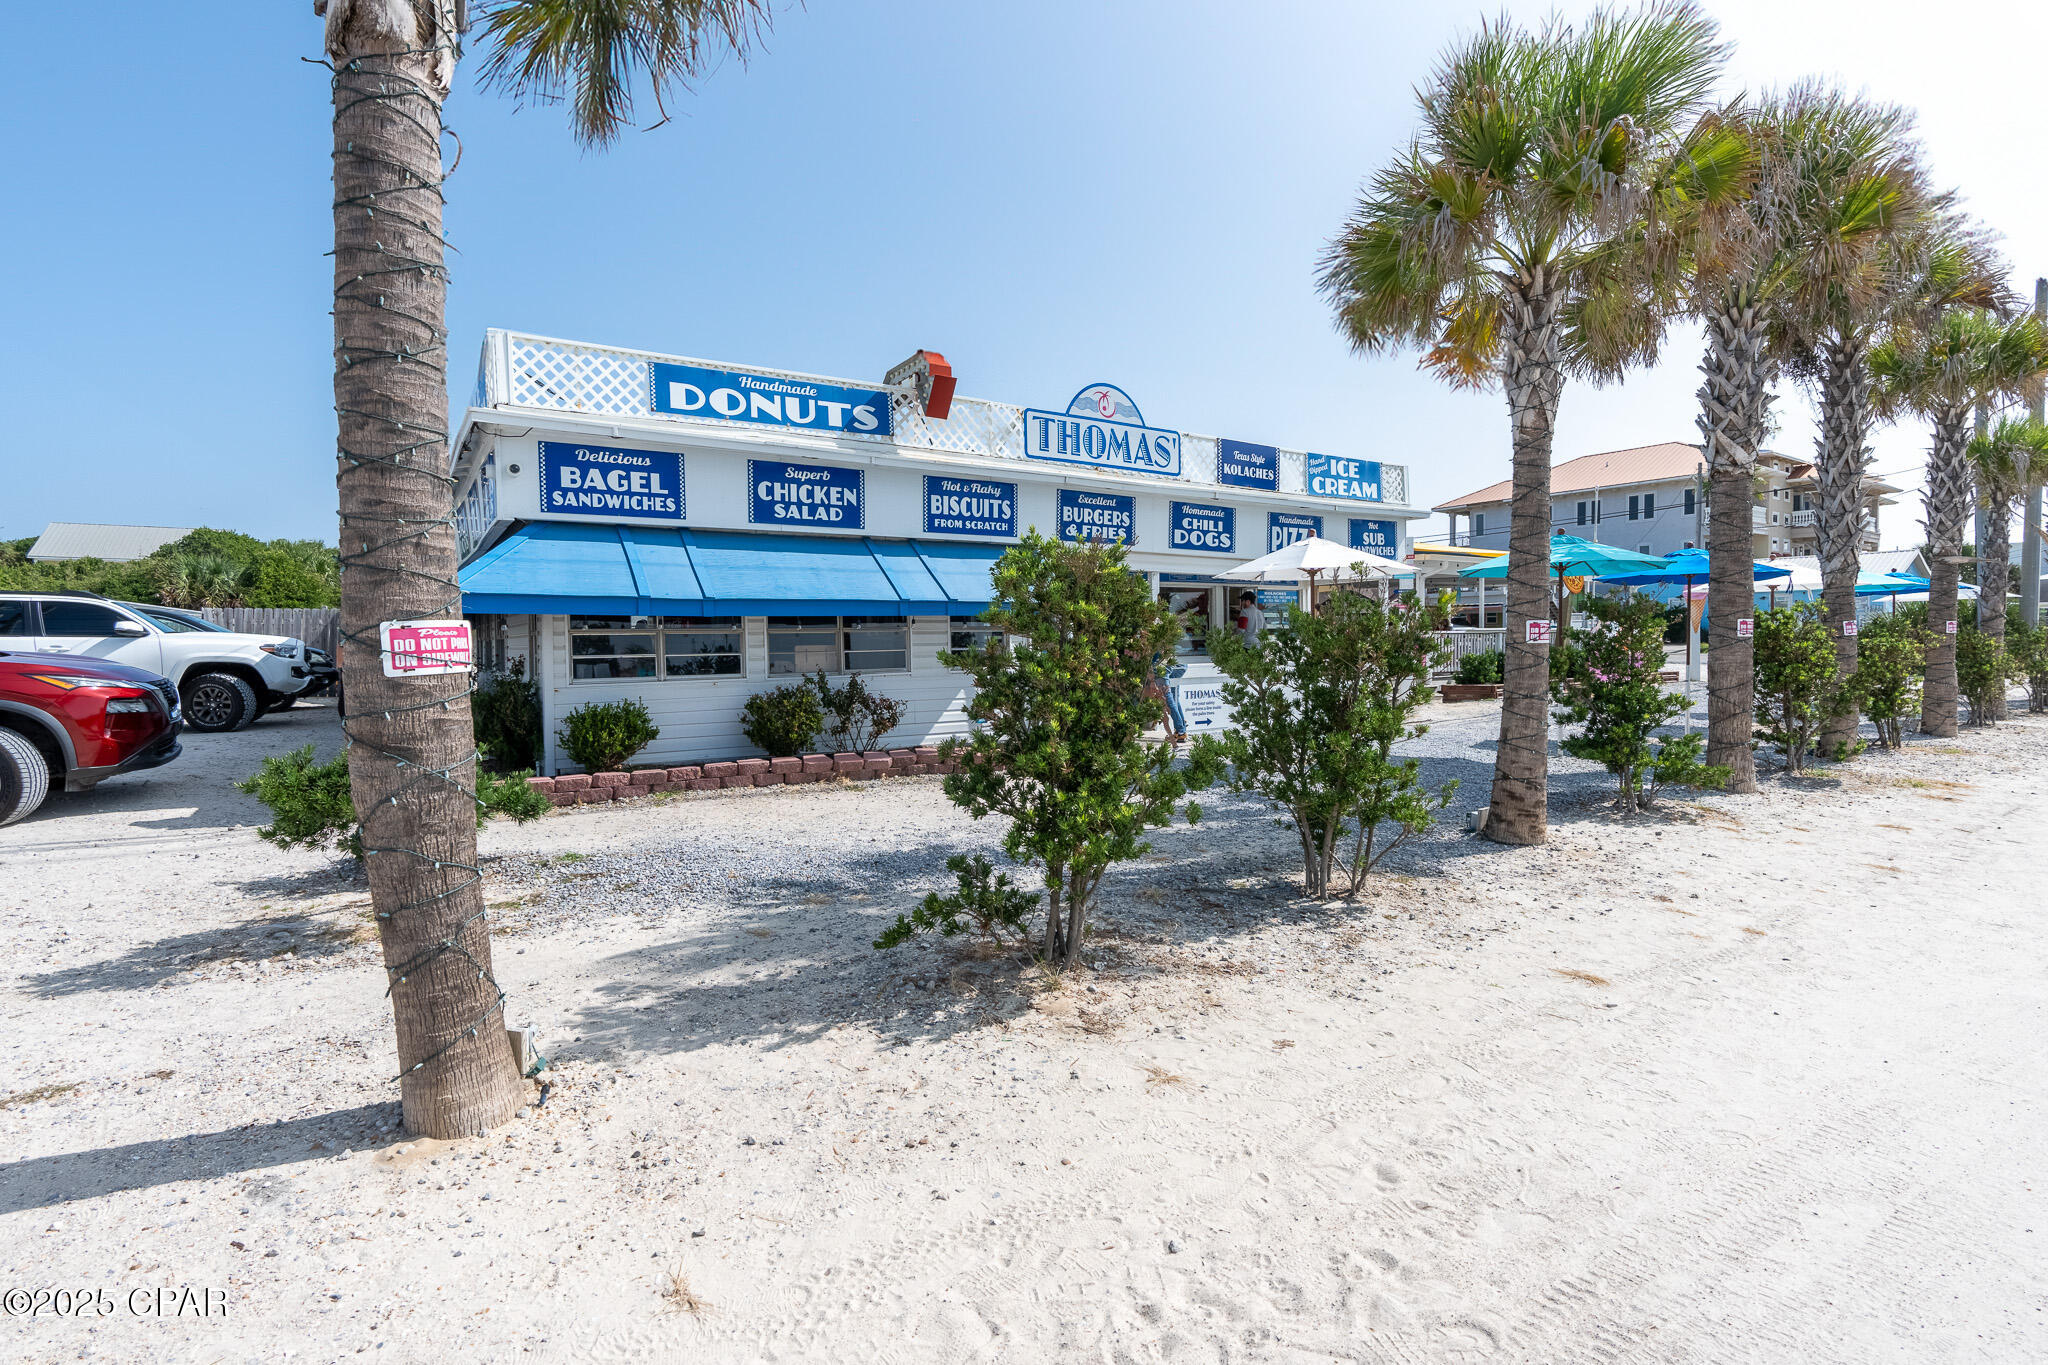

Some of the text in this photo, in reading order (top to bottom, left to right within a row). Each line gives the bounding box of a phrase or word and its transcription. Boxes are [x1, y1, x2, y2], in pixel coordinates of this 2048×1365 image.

[739, 376, 818, 397] Handmade
[669, 381, 879, 431] DONUTS
[1032, 416, 1176, 468] THOMAS'
[575, 449, 652, 466] Delicious
[1233, 451, 1266, 465] Texas Style
[1309, 455, 1326, 467] Hand
[785, 467, 831, 482] Superb
[1223, 463, 1275, 481] KOLACHES
[1309, 463, 1328, 475] Dipped
[1330, 459, 1360, 478] ICE
[560, 466, 669, 494] BAGEL
[1312, 476, 1378, 499] CREAM
[758, 481, 857, 507] CHICKEN
[941, 481, 961, 492] Hot
[970, 483, 1001, 497] Flaky
[552, 491, 676, 512] SANDWICHES
[930, 494, 1011, 519] BISCUITS
[1078, 494, 1117, 507] Excellent
[774, 504, 843, 521] SALAD
[1063, 506, 1130, 527] BURGERS
[1182, 505, 1225, 517] Homemade
[934, 519, 1008, 531] FROM SCRATCH
[1182, 517, 1223, 532] CHILI
[1278, 516, 1315, 525] Handmade
[1066, 524, 1127, 540] & FRIES
[1174, 529, 1231, 548] DOGS
[1272, 526, 1308, 551] PIZ
[1363, 532, 1385, 545] SUB
[393, 639, 415, 651] DO
[420, 637, 448, 651] NOT
[395, 653, 418, 667] ON
